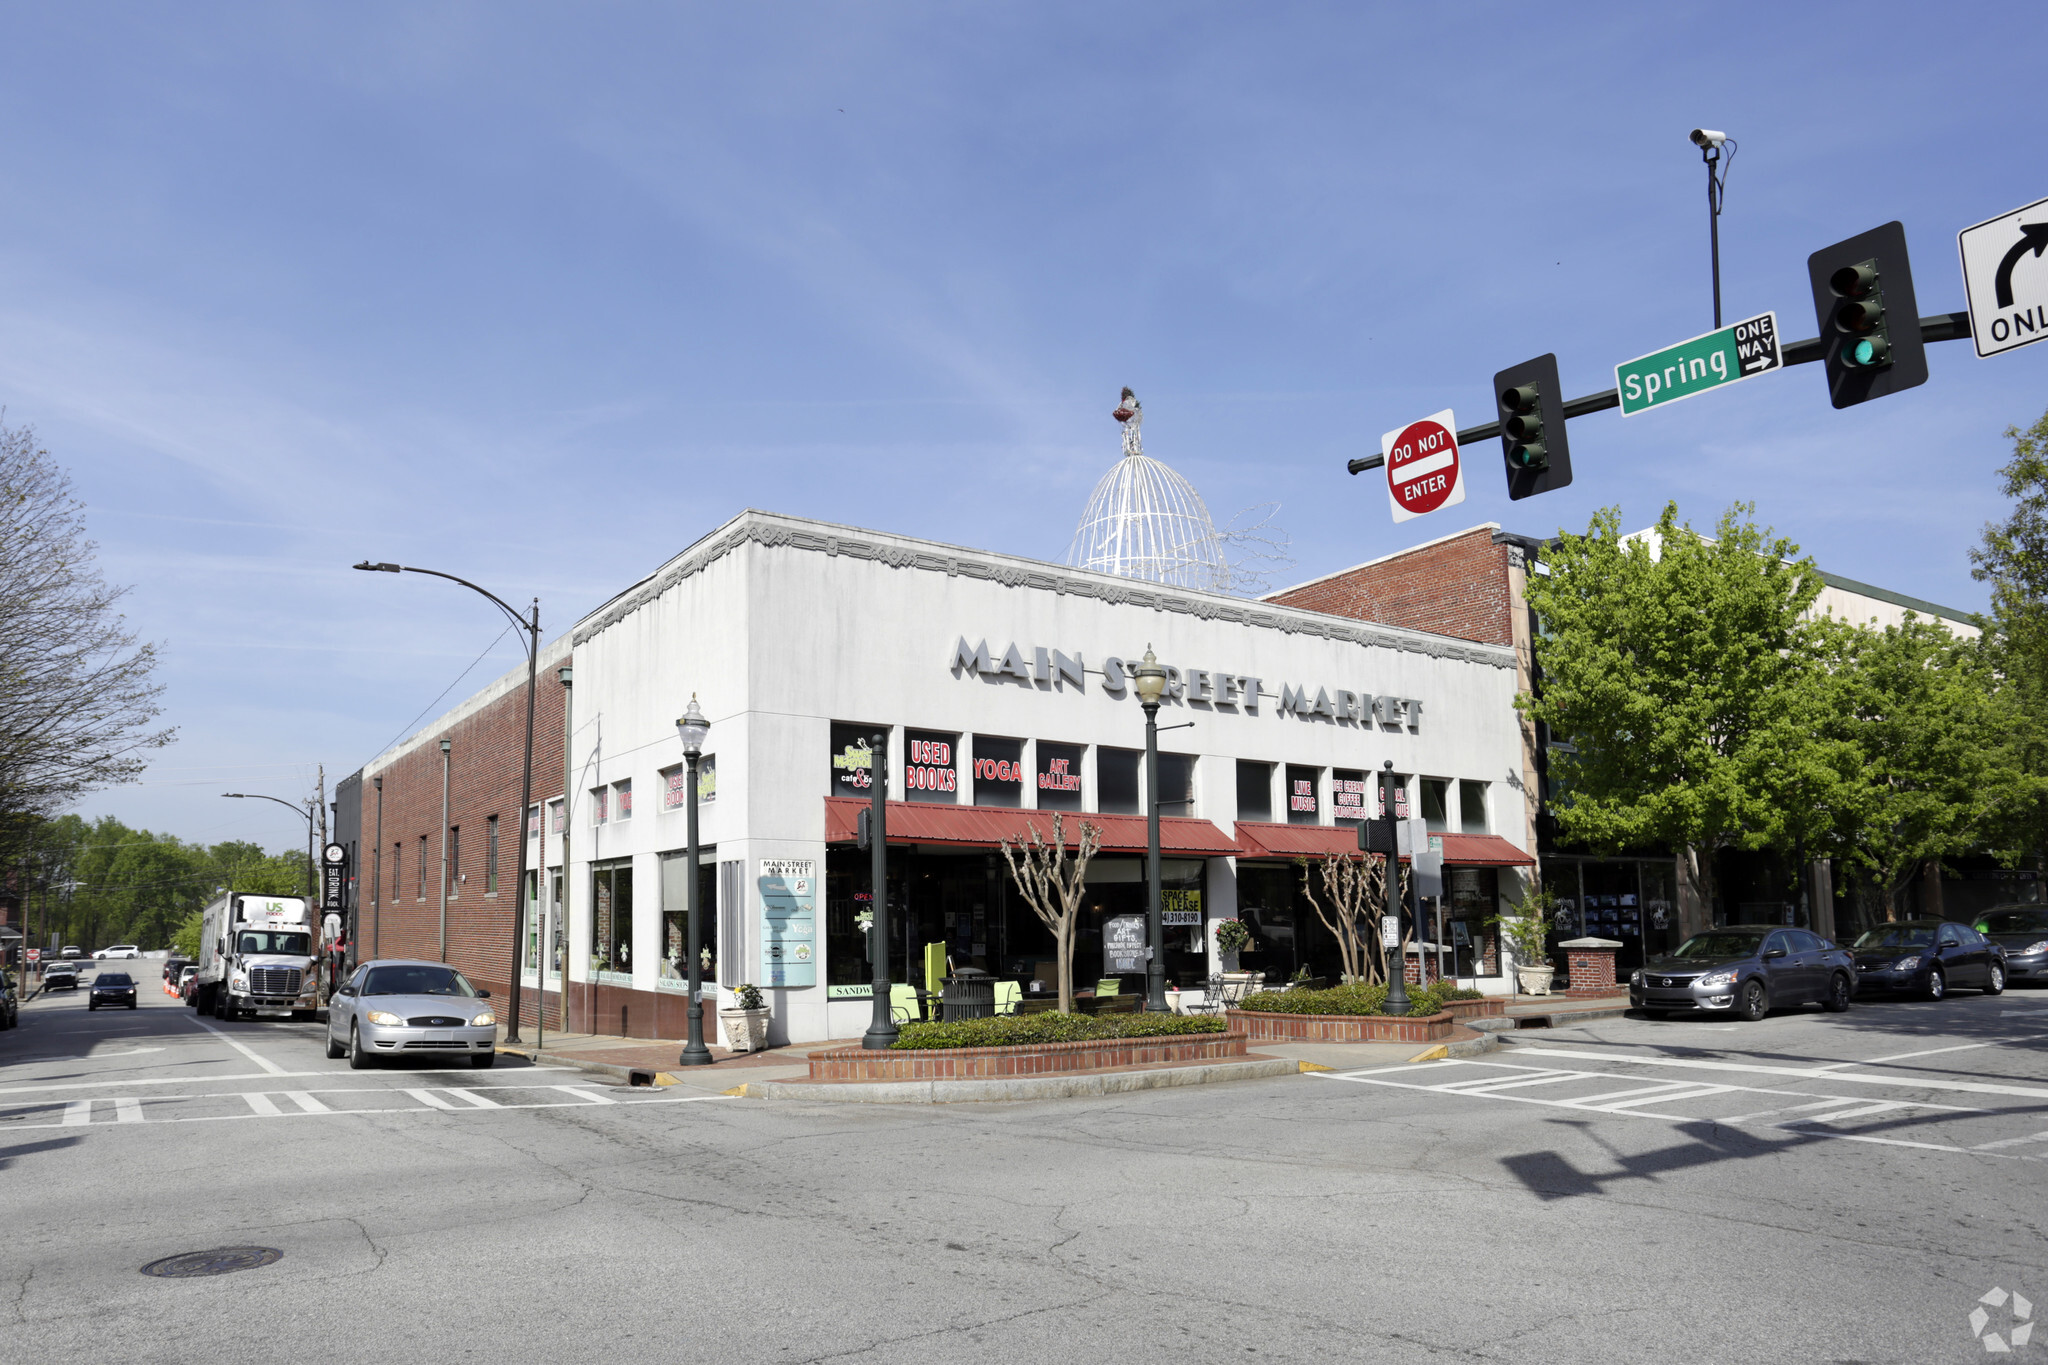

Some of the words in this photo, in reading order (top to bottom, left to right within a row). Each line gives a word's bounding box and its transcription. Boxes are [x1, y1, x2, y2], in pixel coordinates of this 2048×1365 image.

[1736, 318, 1771, 341] ONE
[1738, 335, 1773, 359] WAY
[1625, 350, 1727, 403] Spring
[1394, 444, 1412, 462] DO
[1418, 431, 1444, 453] NOT
[1404, 474, 1447, 501] ENTER
[951, 635, 1084, 686] MAIN
[1276, 681, 1423, 727] MARKET
[911, 740, 950, 765] USED
[973, 758, 1023, 782] YOGA
[1050, 758, 1069, 774] ART
[906, 765, 956, 792] BOOKS
[1038, 773, 1081, 791] GALLERY
[1344, 780, 1365, 794] CREAM
[1294, 780, 1311, 796] LIVE
[1291, 796, 1315, 812] MUSIC
[1338, 793, 1360, 806] COFFEE
[1334, 805, 1366, 819] SMOOTHIES
[768, 867, 808, 875] MARKET
[1162, 891, 1188, 901] SPACE
[1172, 901, 1198, 911] LEASE
[1170, 913, 1198, 922] 310-8190
